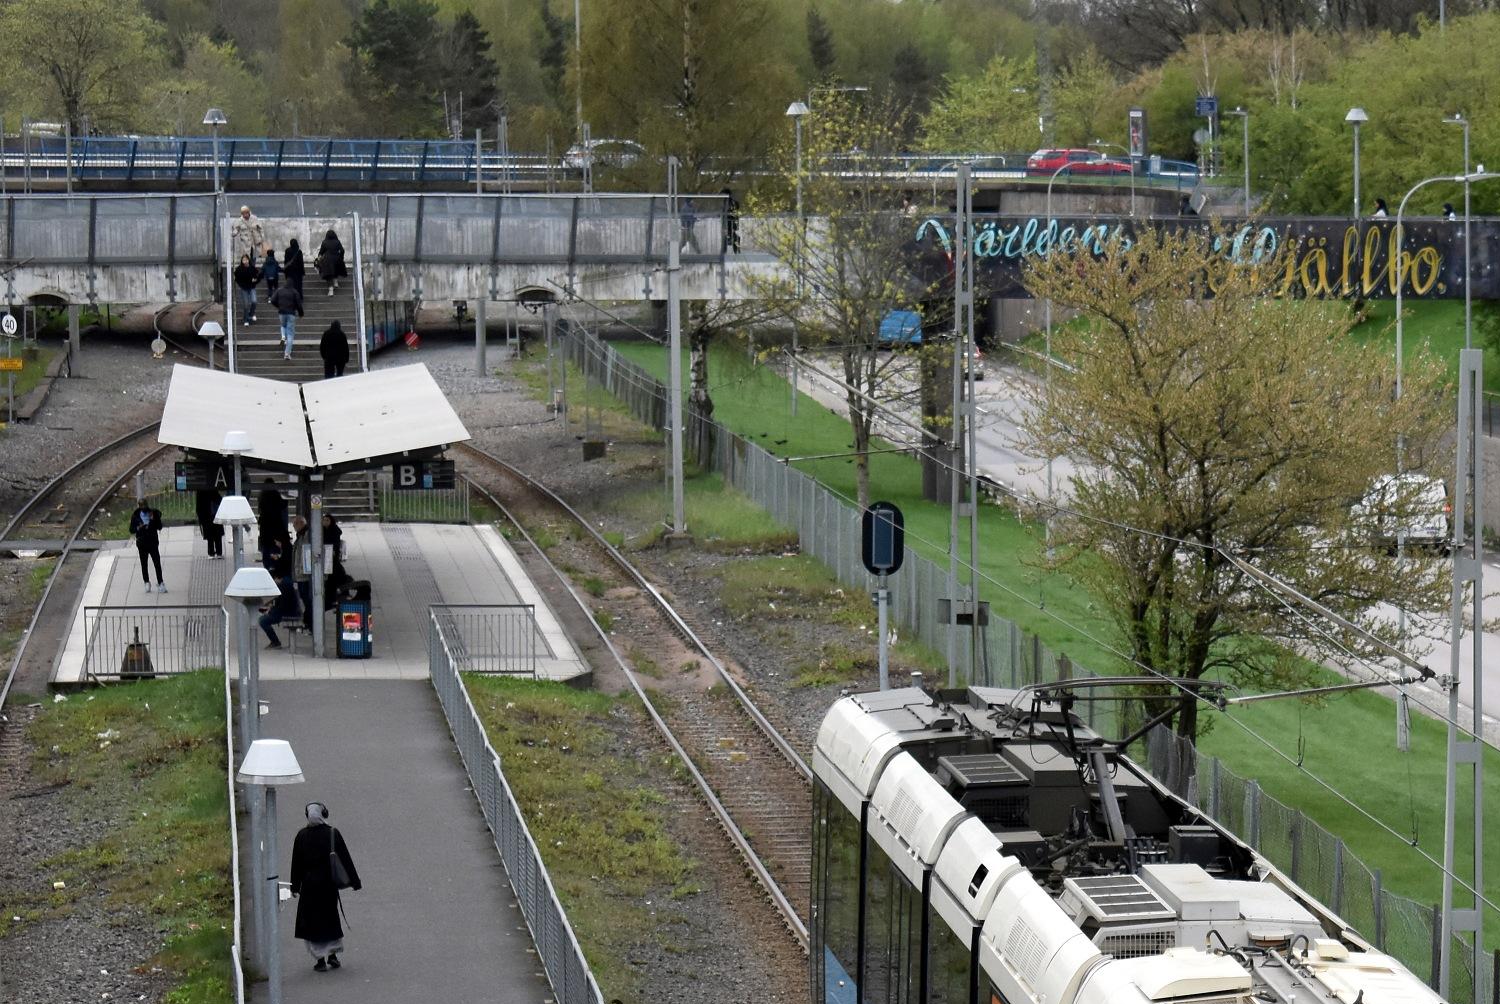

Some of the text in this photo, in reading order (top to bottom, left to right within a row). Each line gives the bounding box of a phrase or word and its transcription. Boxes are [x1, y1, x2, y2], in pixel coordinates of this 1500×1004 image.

[1206, 225, 1447, 297] jällbo.
[5, 320, 14, 331] 40
[214, 466, 227, 487] A
[399, 465, 416, 486] B
